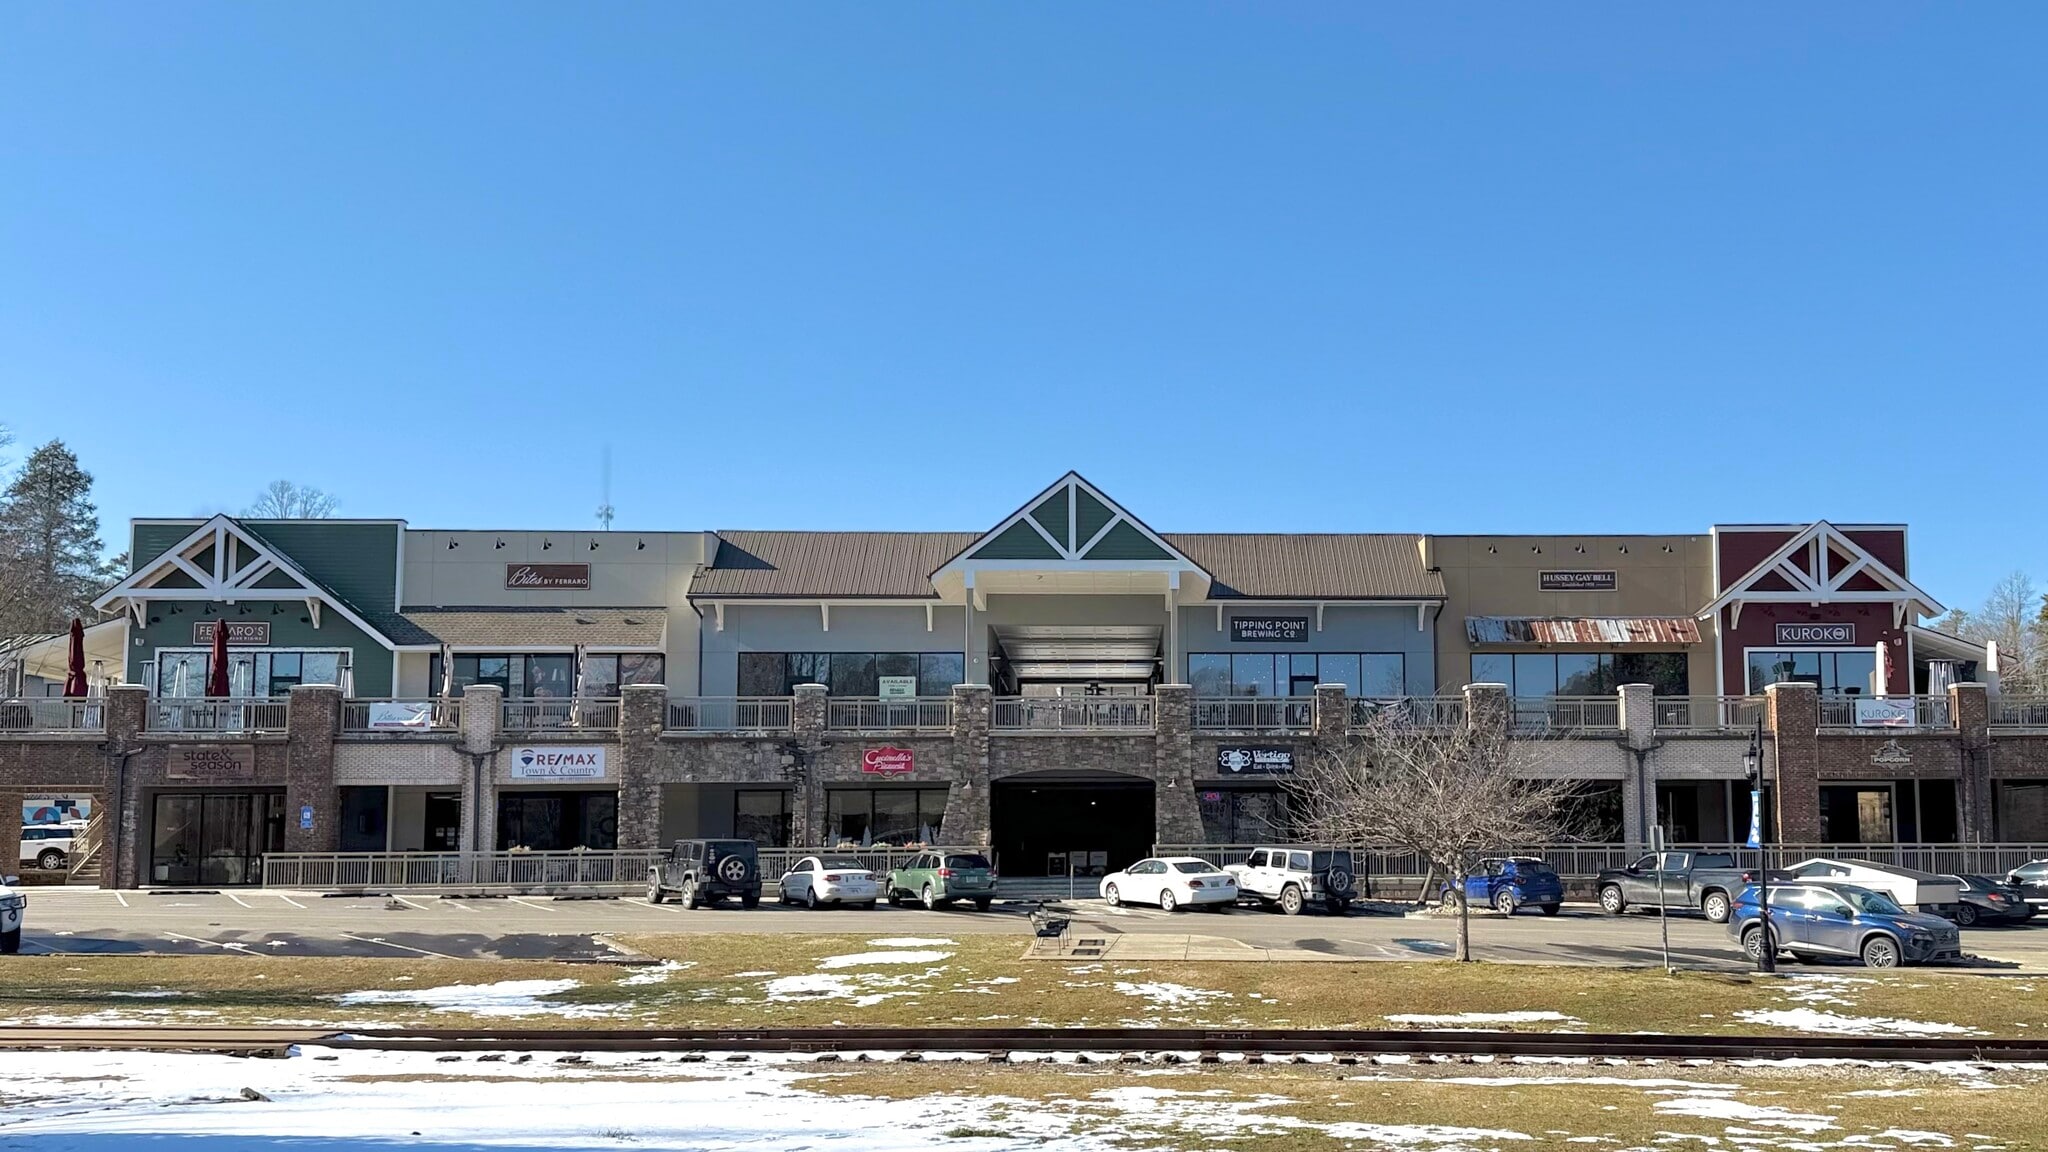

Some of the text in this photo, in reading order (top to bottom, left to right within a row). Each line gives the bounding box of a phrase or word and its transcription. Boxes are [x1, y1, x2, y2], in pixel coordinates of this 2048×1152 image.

[508, 566, 543, 585] Bites
[1543, 574, 1613, 582] HUSSEY GAY BELL
[1234, 620, 1306, 630] TIPPING POINT
[199, 626, 264, 636] FEARO'S
[1241, 630, 1281, 638] BREWING
[1781, 627, 1850, 640] KUROKOI
[1860, 709, 1910, 719] KUROKOI
[536, 753, 597, 766] RE/MAX
[1252, 750, 1291, 762] Vertigo
[190, 761, 242, 770] season
[521, 765, 599, 776] Town & Country
